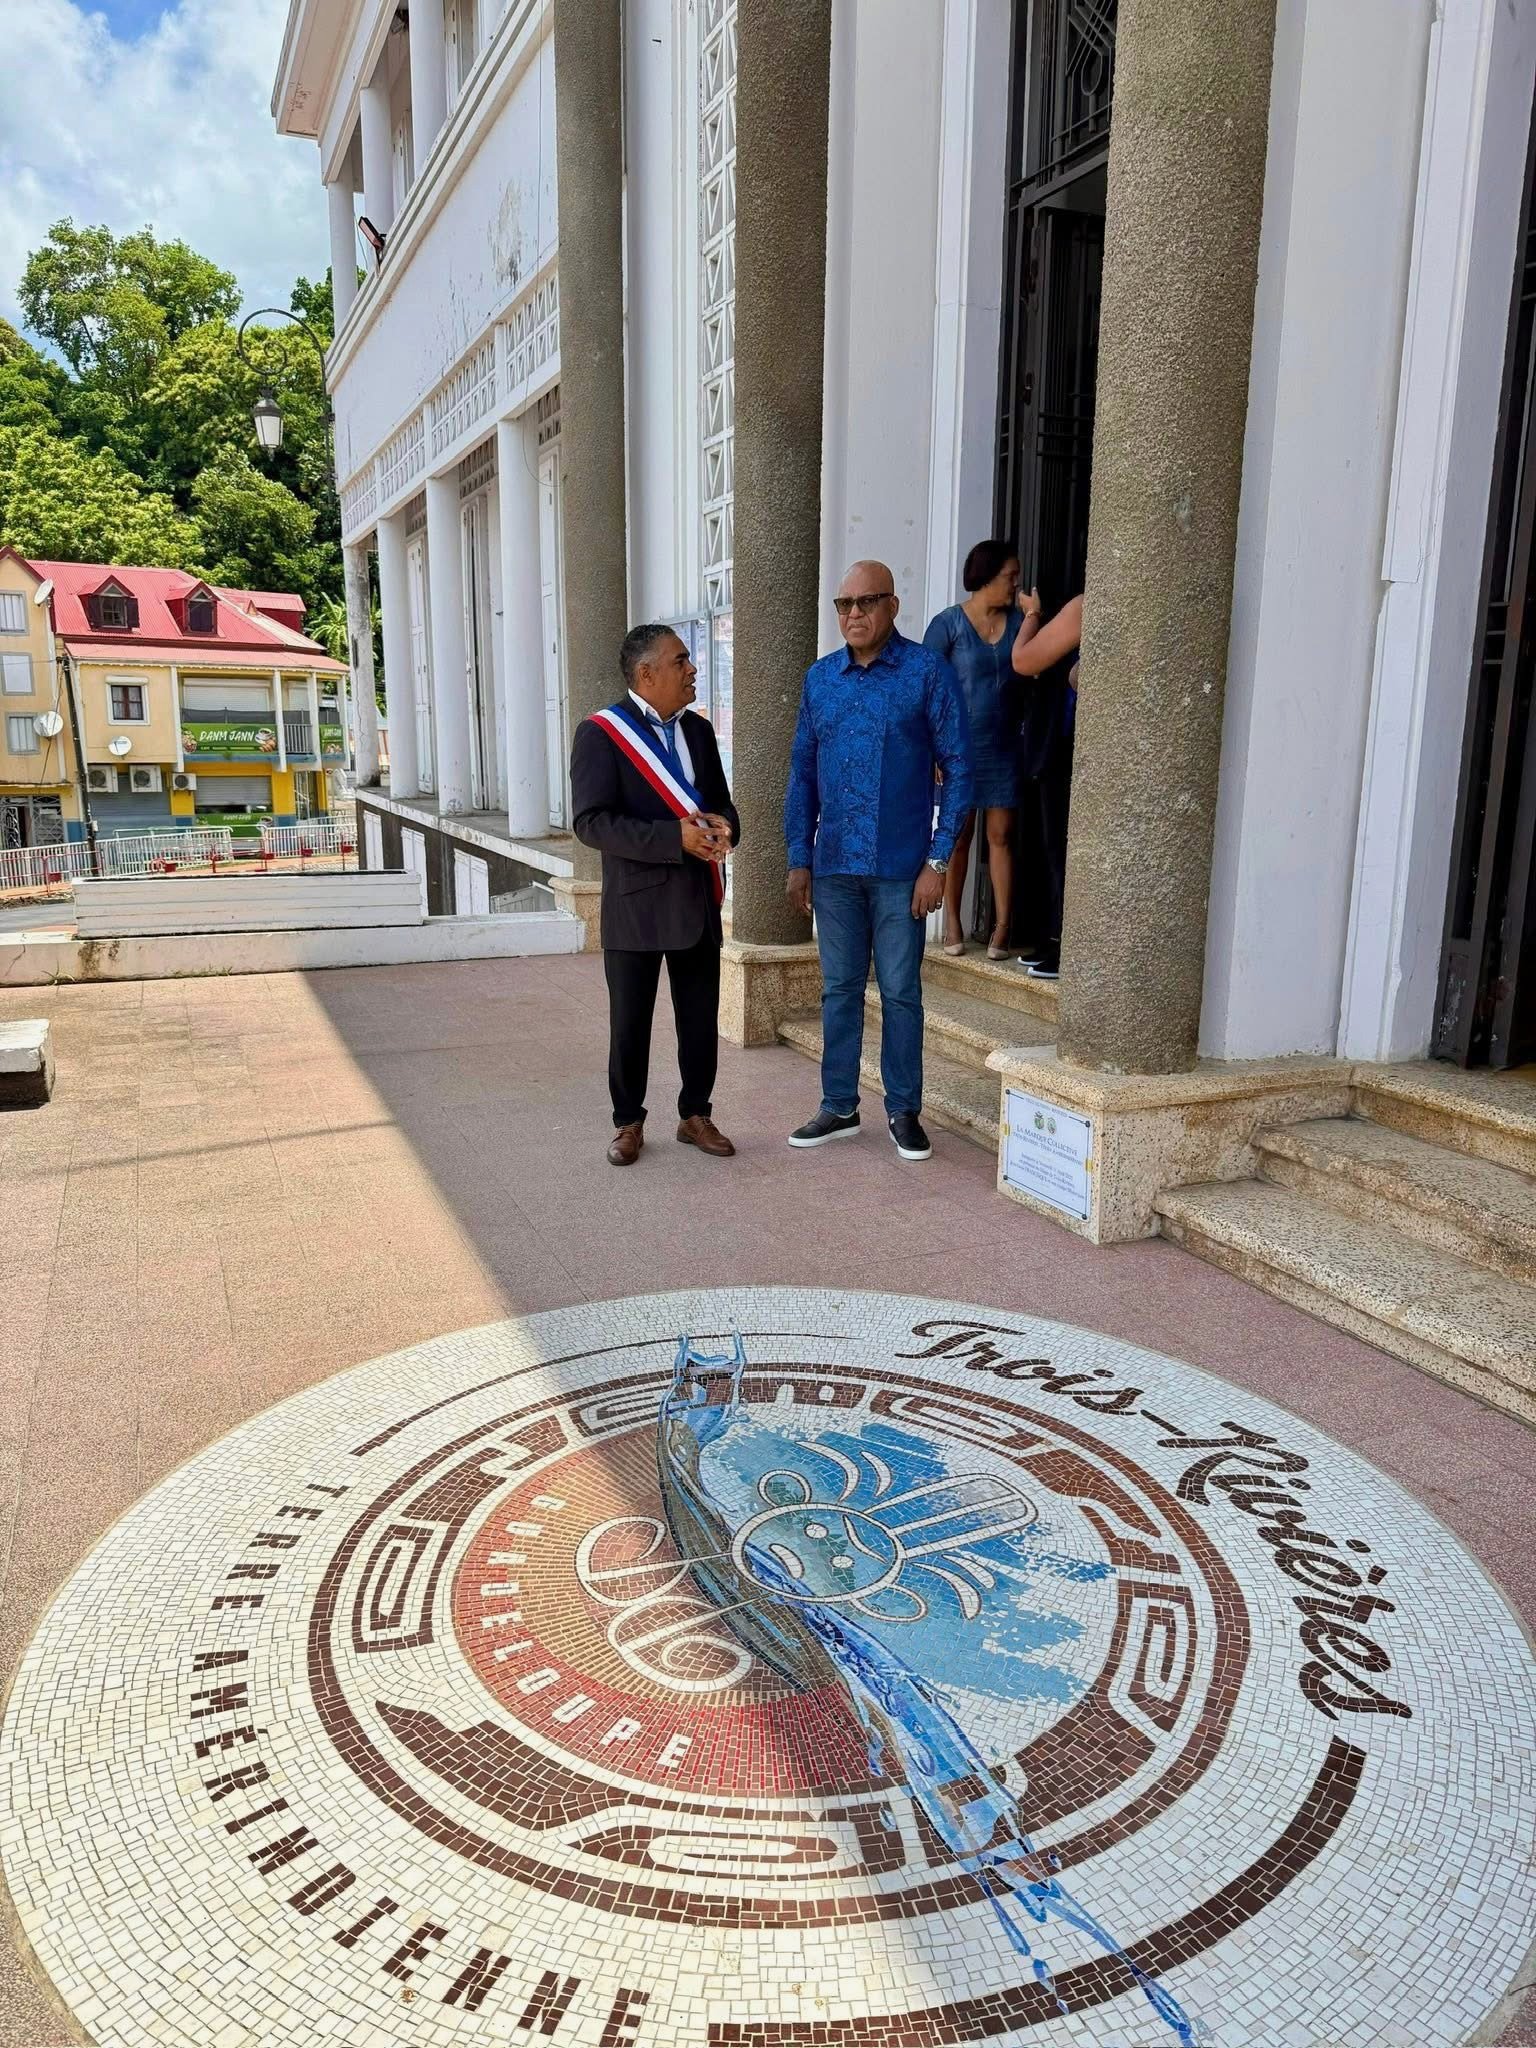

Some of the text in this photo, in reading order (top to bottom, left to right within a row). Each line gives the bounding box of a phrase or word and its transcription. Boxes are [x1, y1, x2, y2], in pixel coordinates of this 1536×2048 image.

[199, 730, 254, 742] DANM JANN
[480, 1494, 693, 1768] GUADELOUPE
[895, 1320, 1412, 1720] Trois-Rivières
[190, 1483, 650, 2048] TERRE AMÉRINDIENNE
